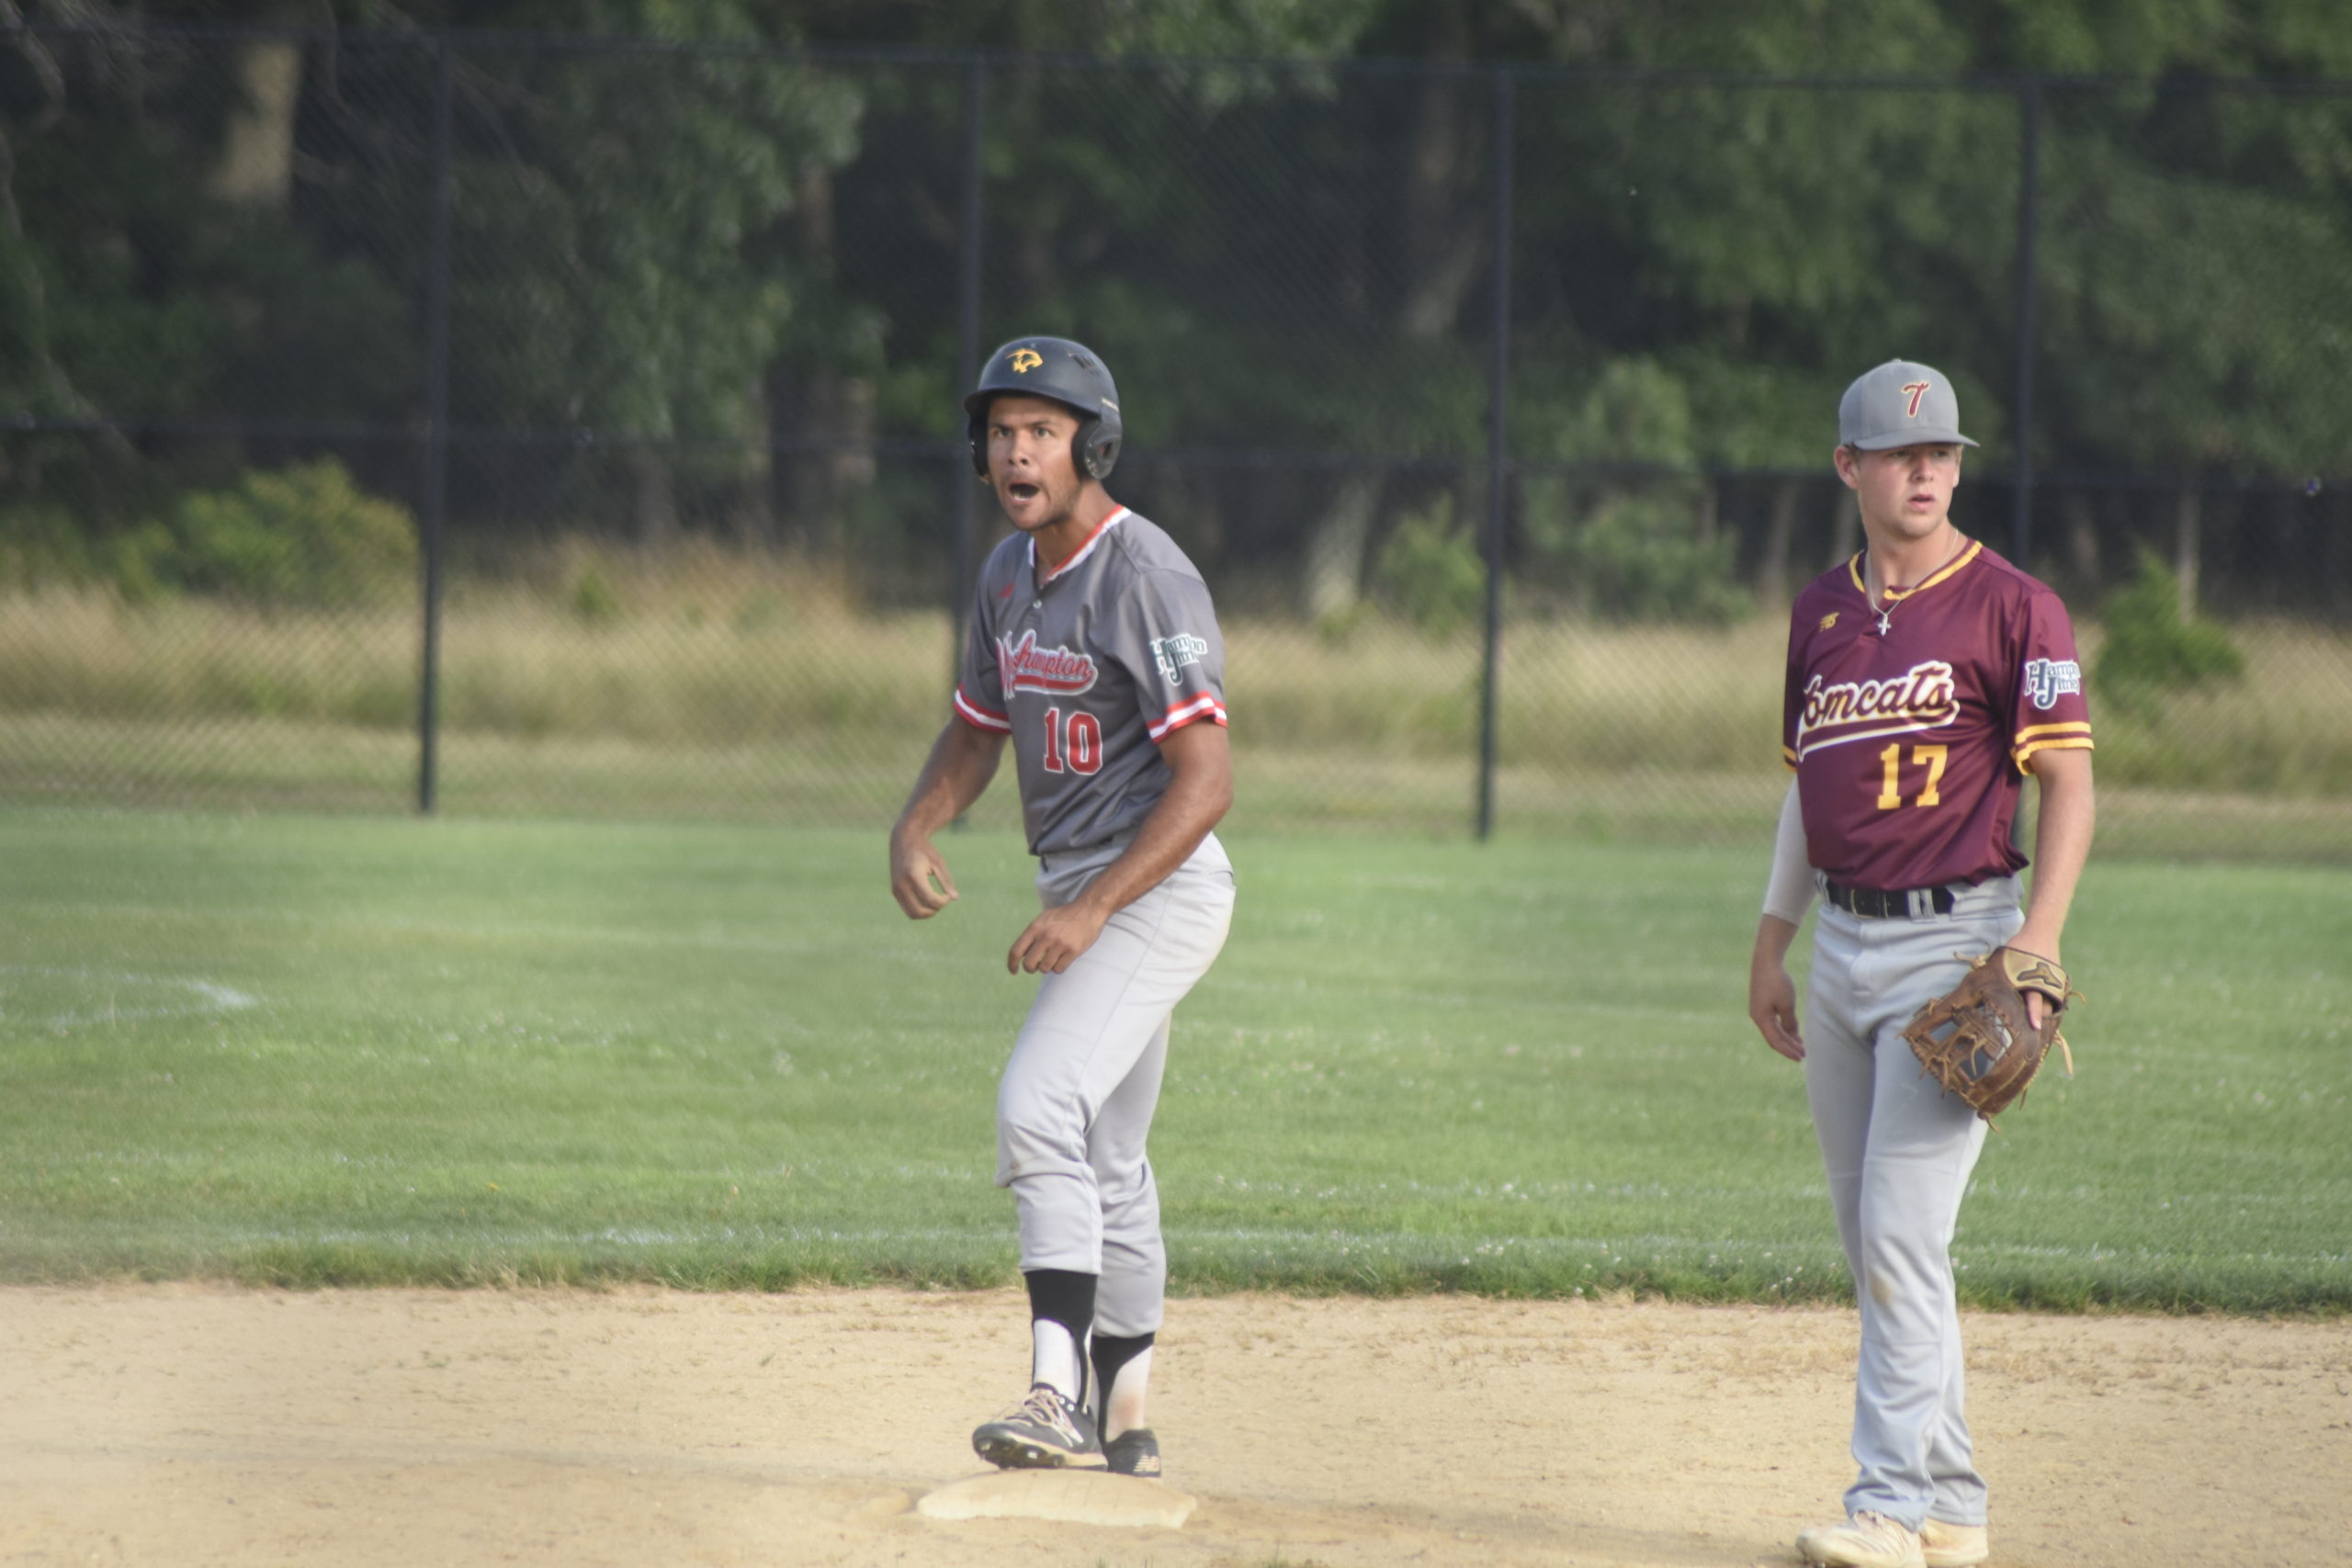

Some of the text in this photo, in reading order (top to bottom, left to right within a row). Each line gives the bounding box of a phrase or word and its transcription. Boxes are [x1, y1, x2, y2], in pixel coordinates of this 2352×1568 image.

[1900, 381, 1930, 418] T
[1798, 660, 1959, 732] omcats
[1044, 706, 1102, 775] 10
[1877, 743, 1948, 809] 17
